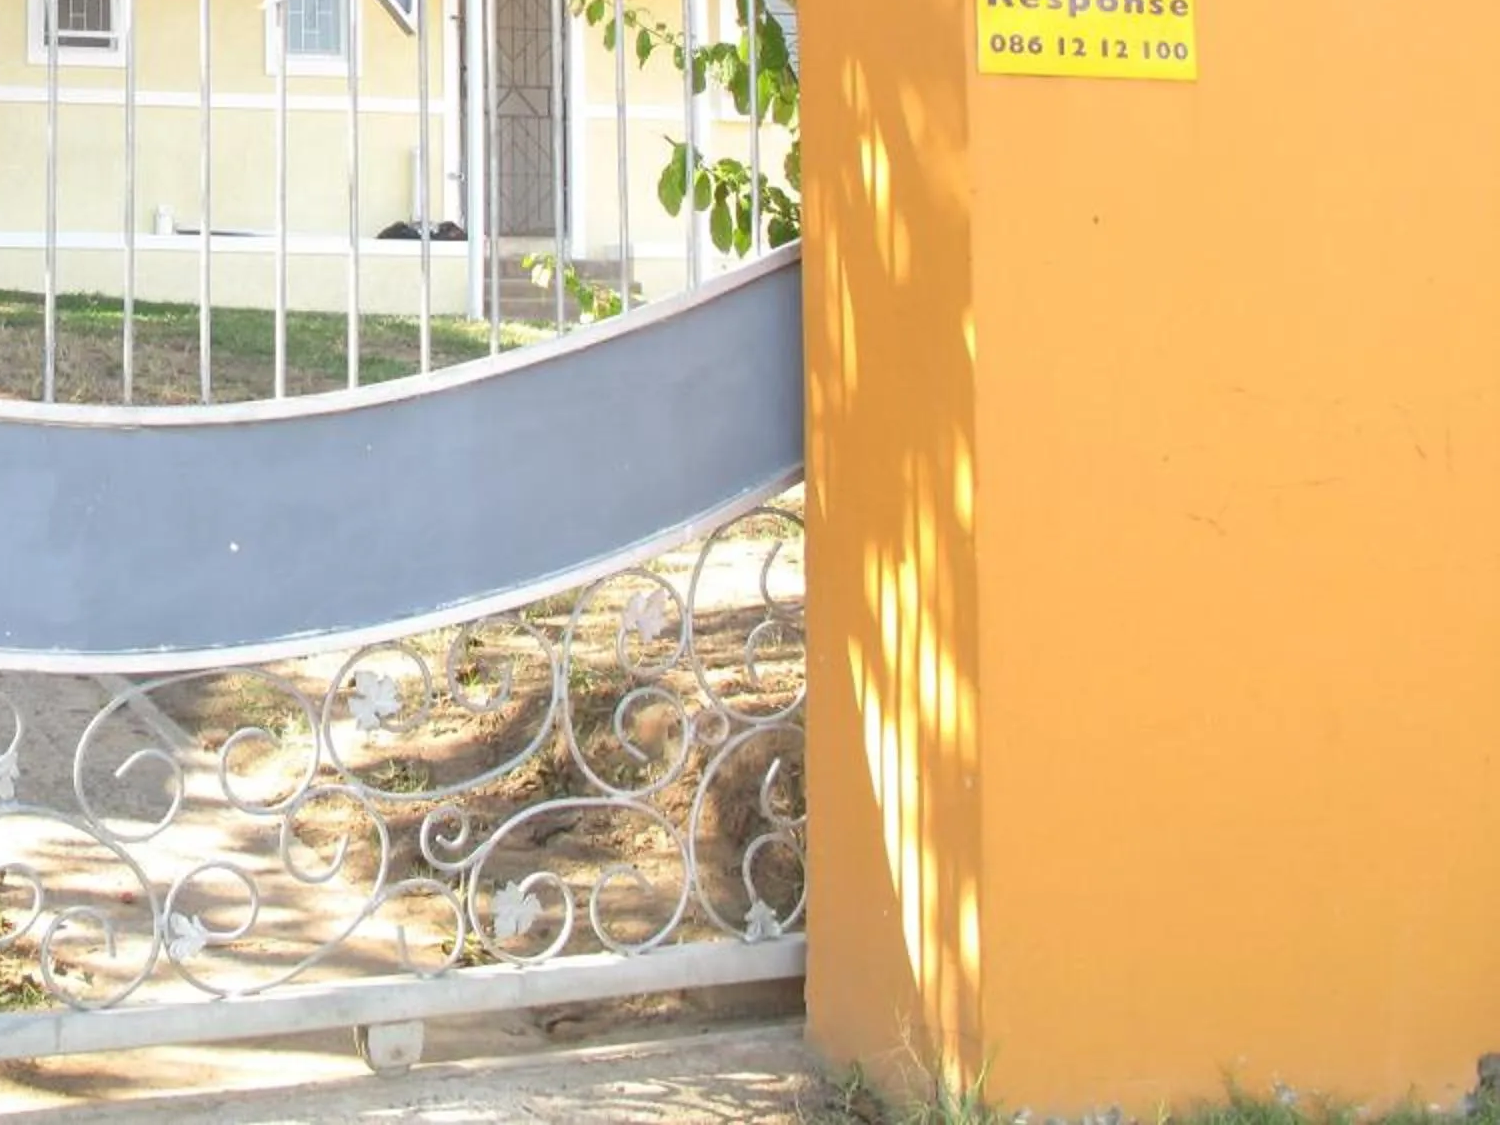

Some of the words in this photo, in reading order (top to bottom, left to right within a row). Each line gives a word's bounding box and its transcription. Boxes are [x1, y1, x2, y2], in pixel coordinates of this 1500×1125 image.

[989, 33, 1044, 55] 086
[1057, 36, 1087, 58] 12
[1100, 37, 1129, 59] 12
[1142, 40, 1189, 61] 100
